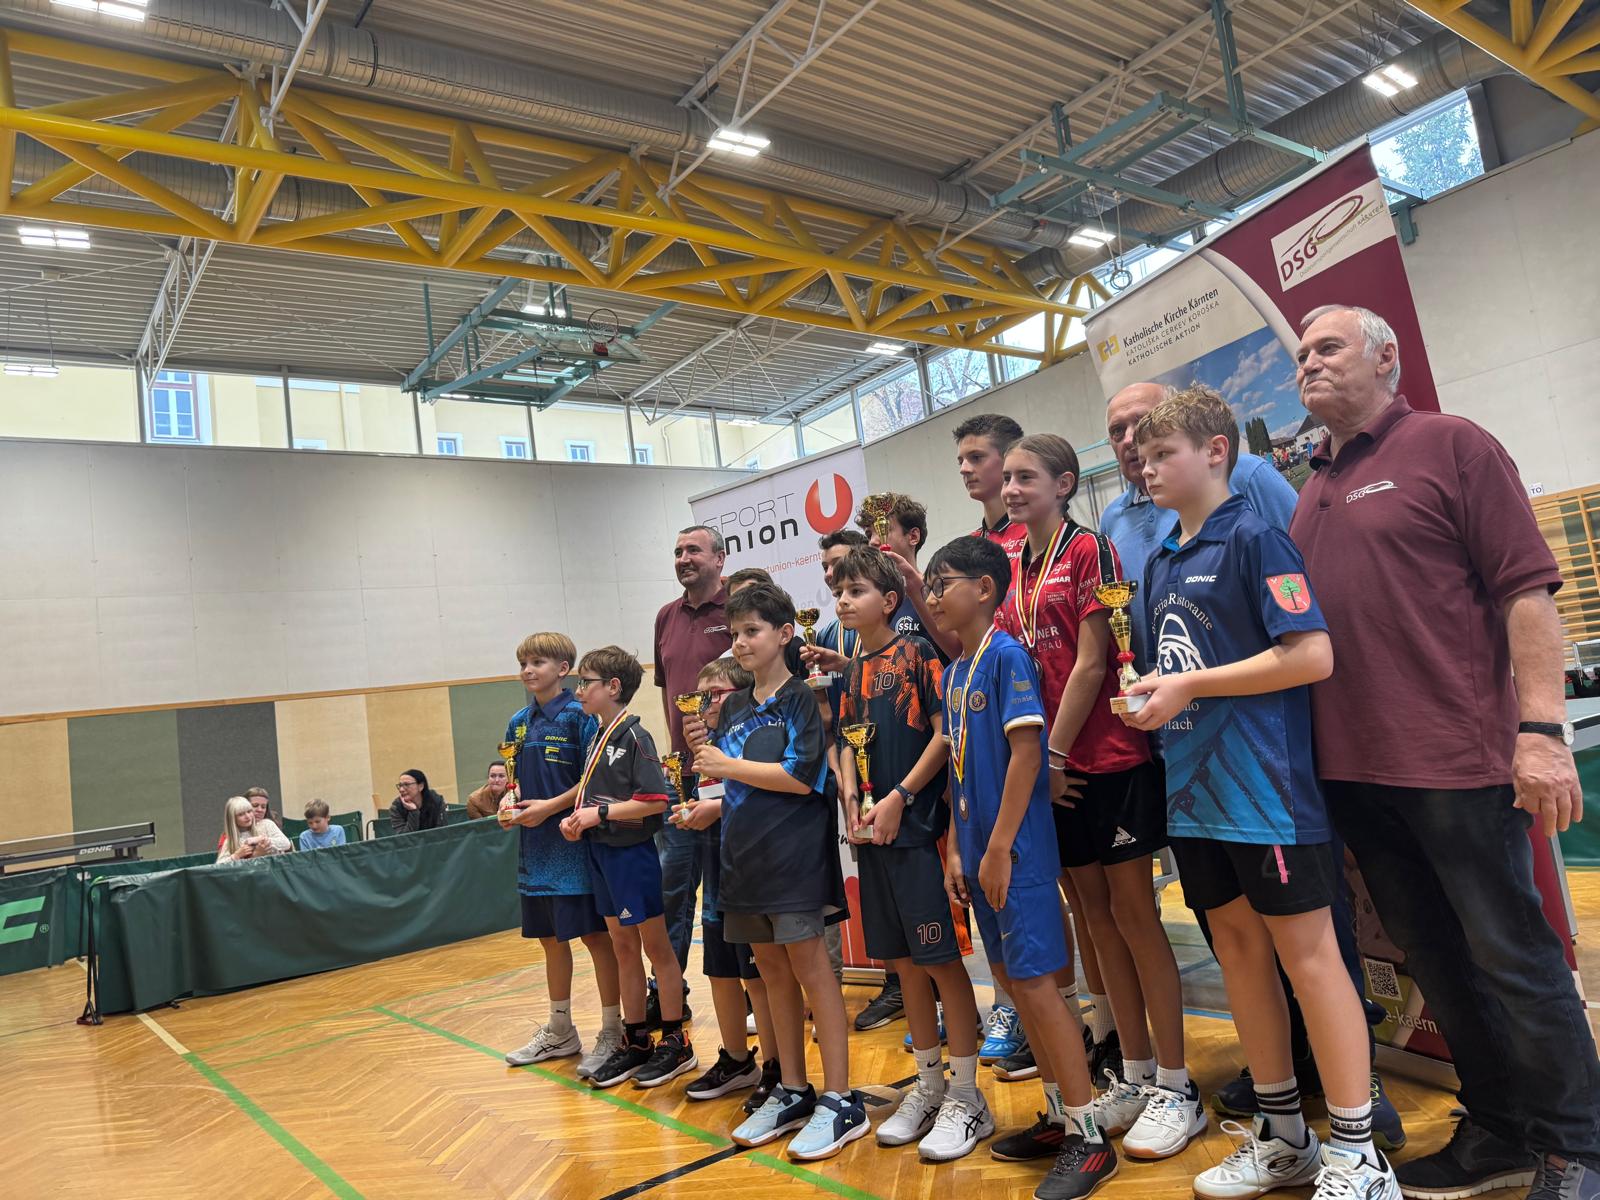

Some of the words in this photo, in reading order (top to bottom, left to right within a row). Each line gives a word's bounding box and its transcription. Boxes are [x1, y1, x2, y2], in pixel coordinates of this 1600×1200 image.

[1281, 237, 1318, 282] DSG
[1123, 319, 1163, 348] Katholische
[1163, 305, 1188, 326] Kirche
[1187, 288, 1219, 312] Kärnten
[1161, 319, 1187, 338] CERKEV
[1188, 300, 1220, 323] KOROŠKA
[1128, 337, 1173, 367] KATHOLISCHE
[1175, 322, 1201, 342] AKTION
[1346, 491, 1365, 504] DSG
[725, 518, 799, 555] nion
[1185, 575, 1217, 584] DONIC
[1168, 592, 1213, 632] Ristorante
[898, 622, 920, 631] SSLK
[873, 671, 896, 692] 10
[79, 844, 113, 855] DONIC
[916, 921, 942, 945] 10
[1386, 1006, 1442, 1035] e-kaern
[1083, 1112, 1098, 1138] SUNNY
